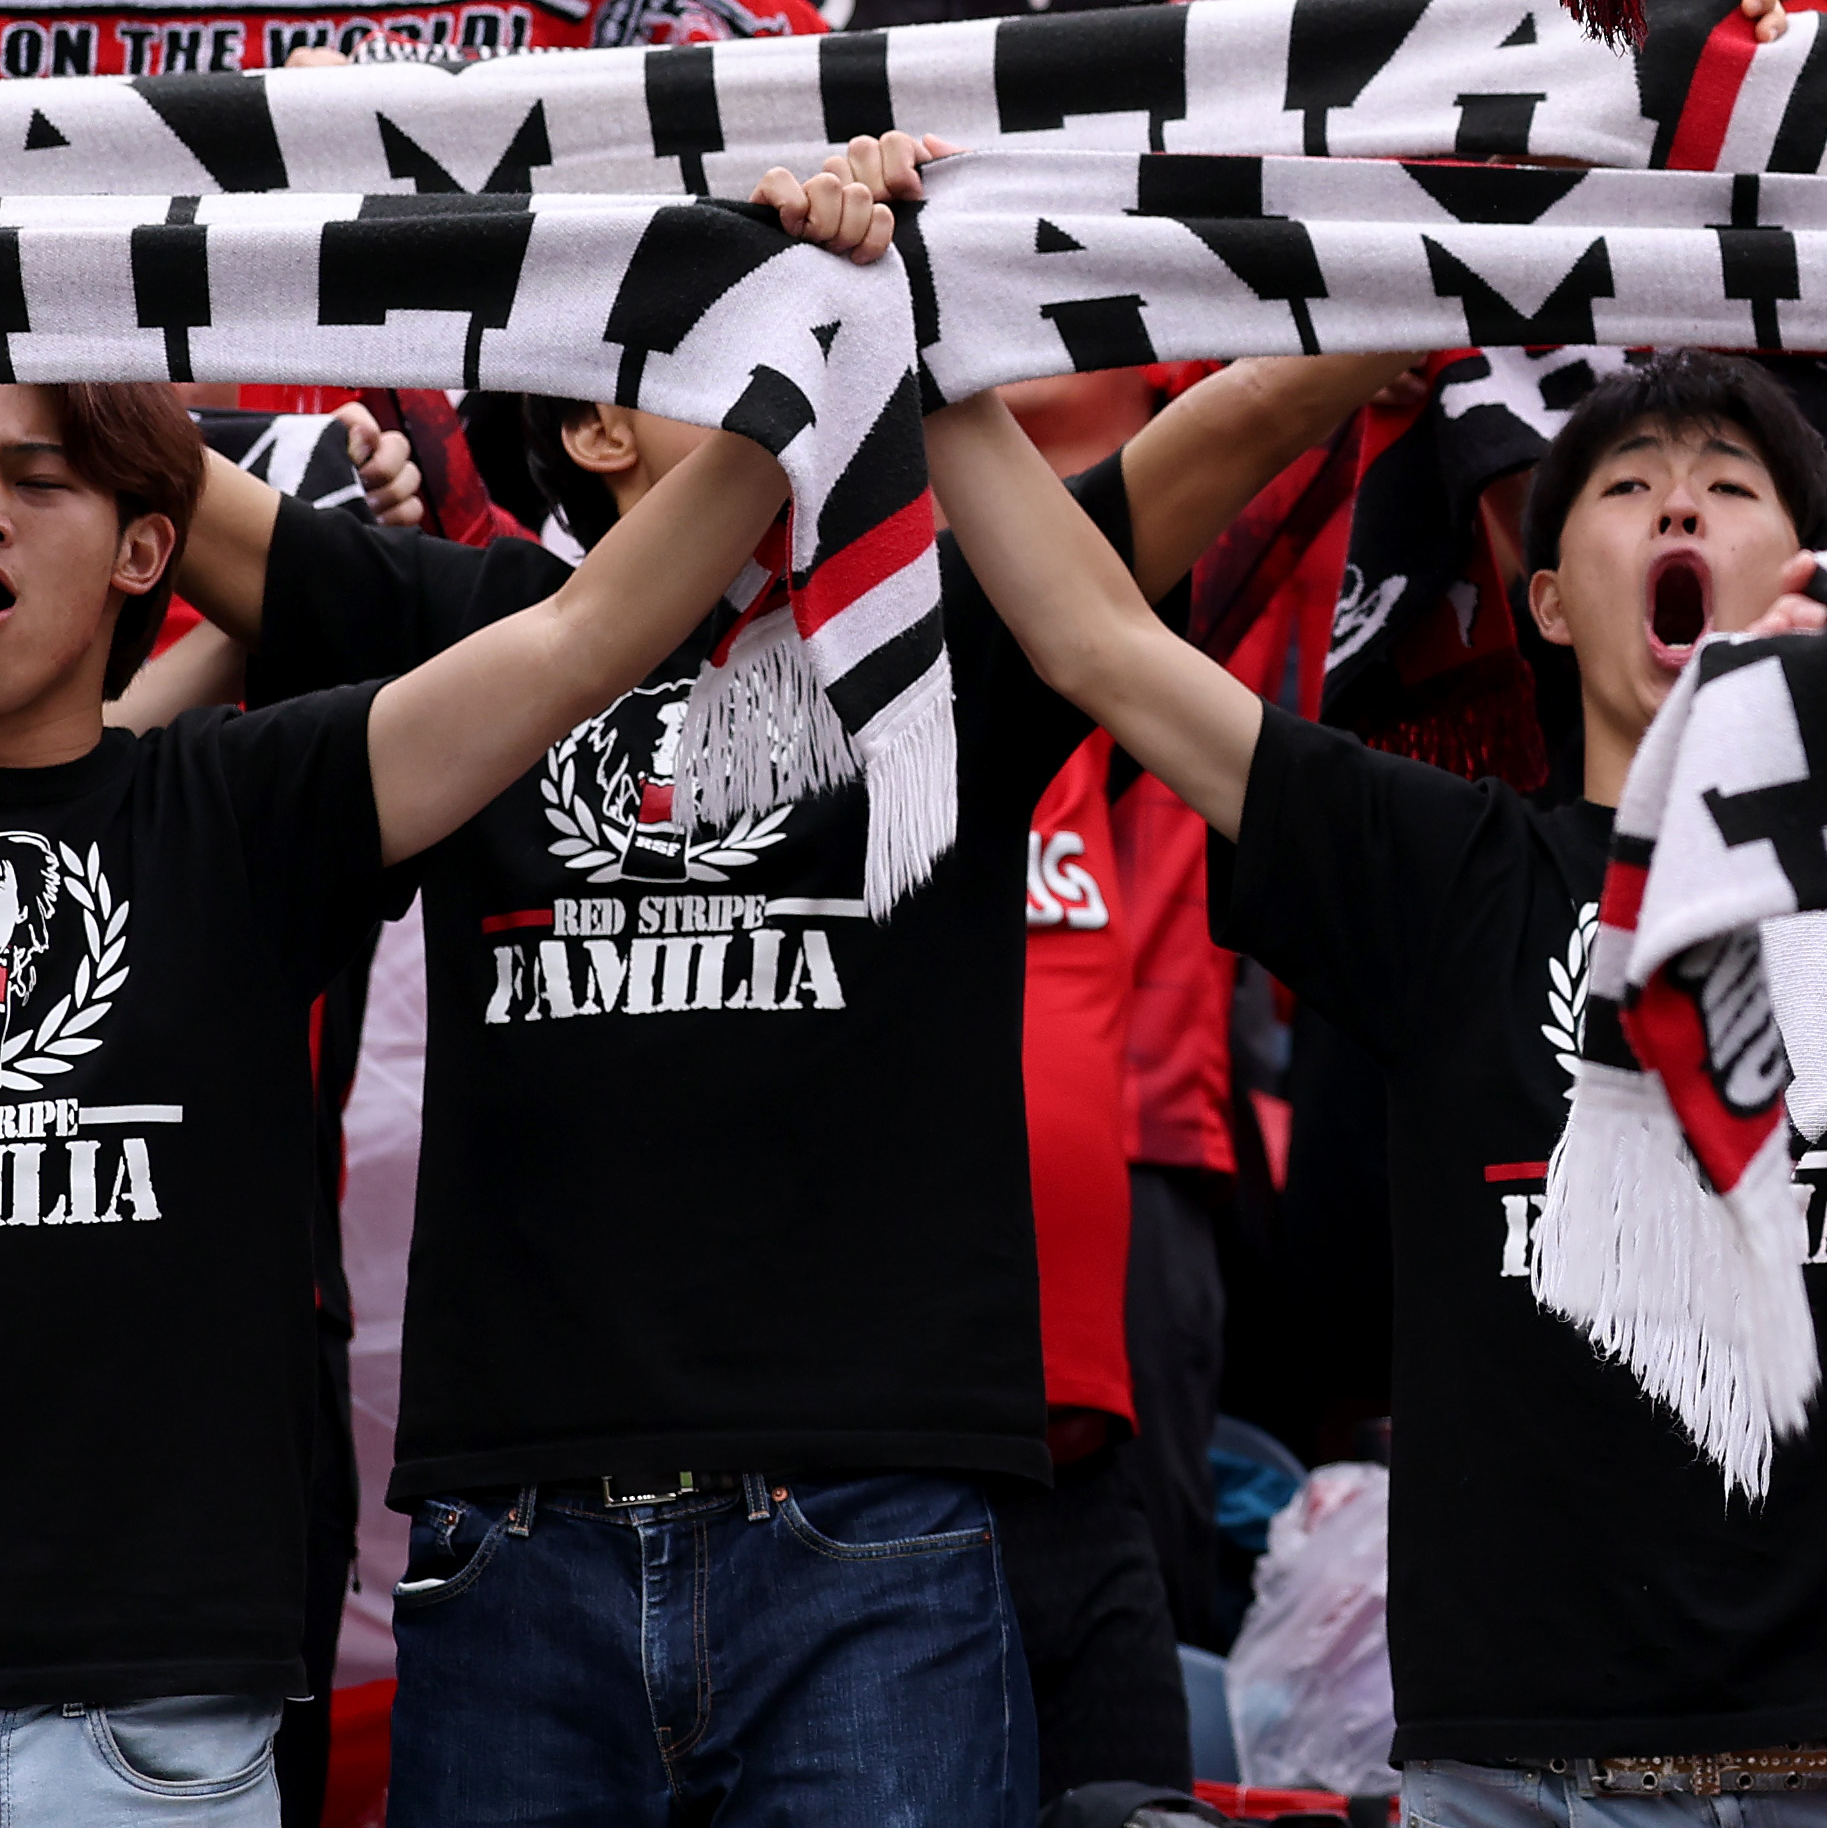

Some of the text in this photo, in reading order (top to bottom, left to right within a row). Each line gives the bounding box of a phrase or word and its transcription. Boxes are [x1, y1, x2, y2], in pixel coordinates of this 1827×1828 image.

[113, 20, 245, 77] THE
[553, 895, 766, 936] RED STRIPE
[485, 929, 847, 1024] FAMILIA
